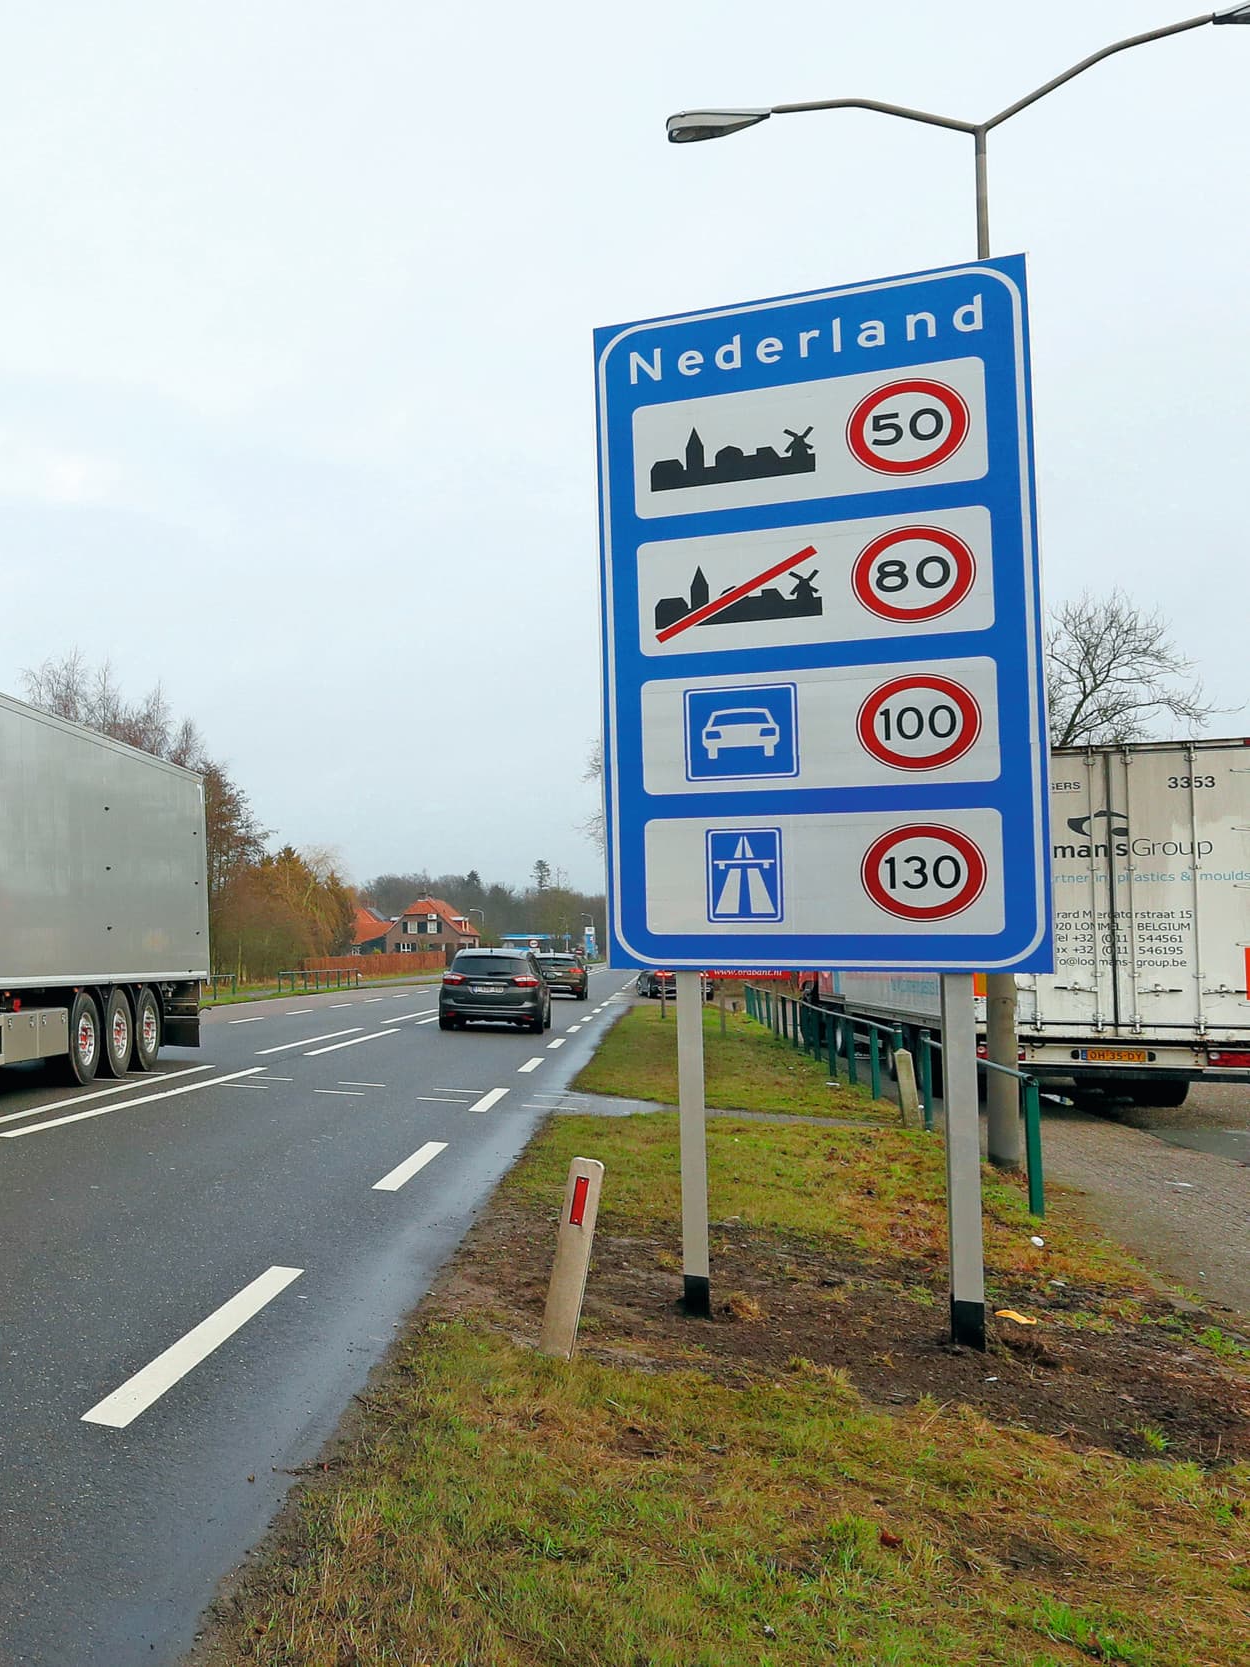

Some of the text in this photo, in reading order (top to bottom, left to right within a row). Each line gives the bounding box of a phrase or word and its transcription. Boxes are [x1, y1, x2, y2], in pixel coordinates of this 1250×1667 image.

[629, 293, 984, 384] Nederland
[871, 408, 944, 446] 50
[876, 556, 950, 592] 80
[879, 705, 956, 741] 100
[1168, 776, 1216, 789] 3353
[884, 855, 961, 889] 130
[1053, 870, 1250, 885] rtner in plastics & moulds
[1054, 910, 1080, 919] rard
[1180, 910, 1192, 919] 15
[1137, 922, 1190, 931] BELGIUM
[1072, 934, 1094, 943] +32
[1138, 934, 1183, 943] 544561
[1072, 945, 1094, 954] +32
[1101, 945, 1128, 957] (011
[1138, 945, 1183, 955] 546195
